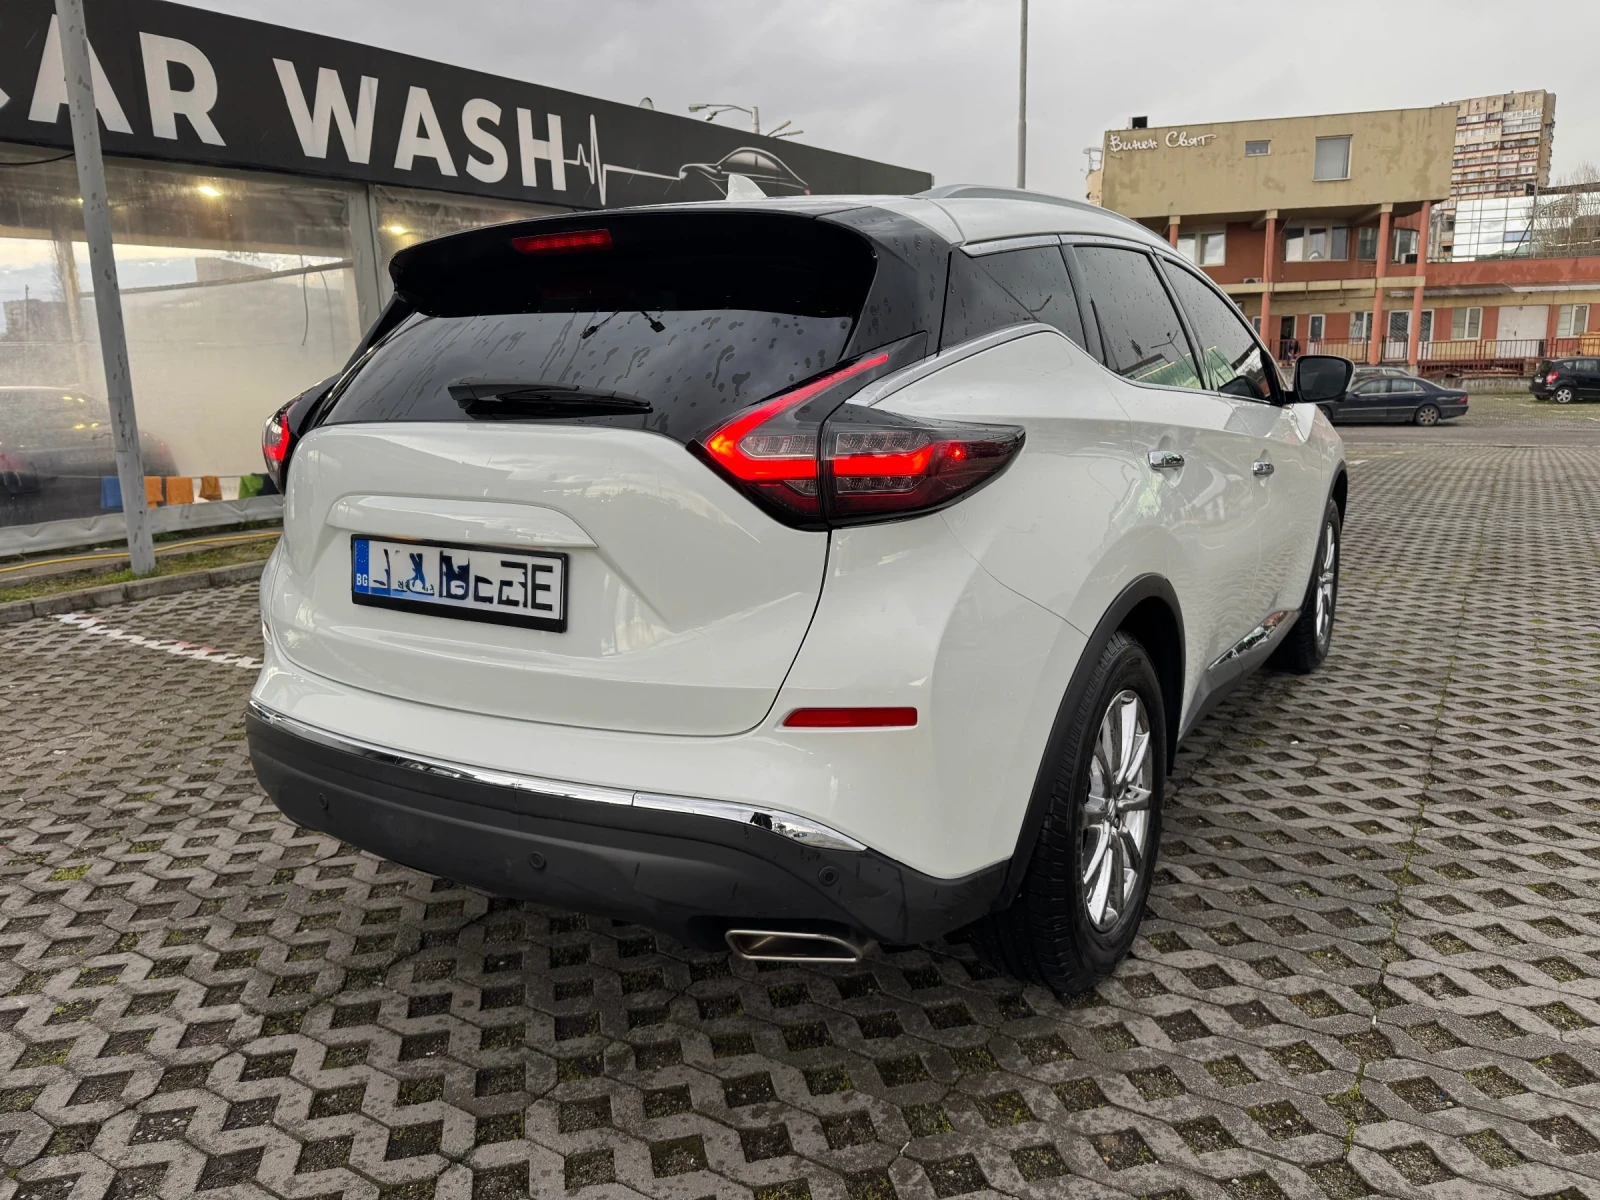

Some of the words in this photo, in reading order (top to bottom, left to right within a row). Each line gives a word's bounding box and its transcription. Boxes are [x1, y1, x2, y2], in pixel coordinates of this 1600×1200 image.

[0, 13, 227, 146] AR
[272, 57, 567, 191] WASH
[1165, 131, 1217, 147] Свят
[356, 573, 368, 586] BG
